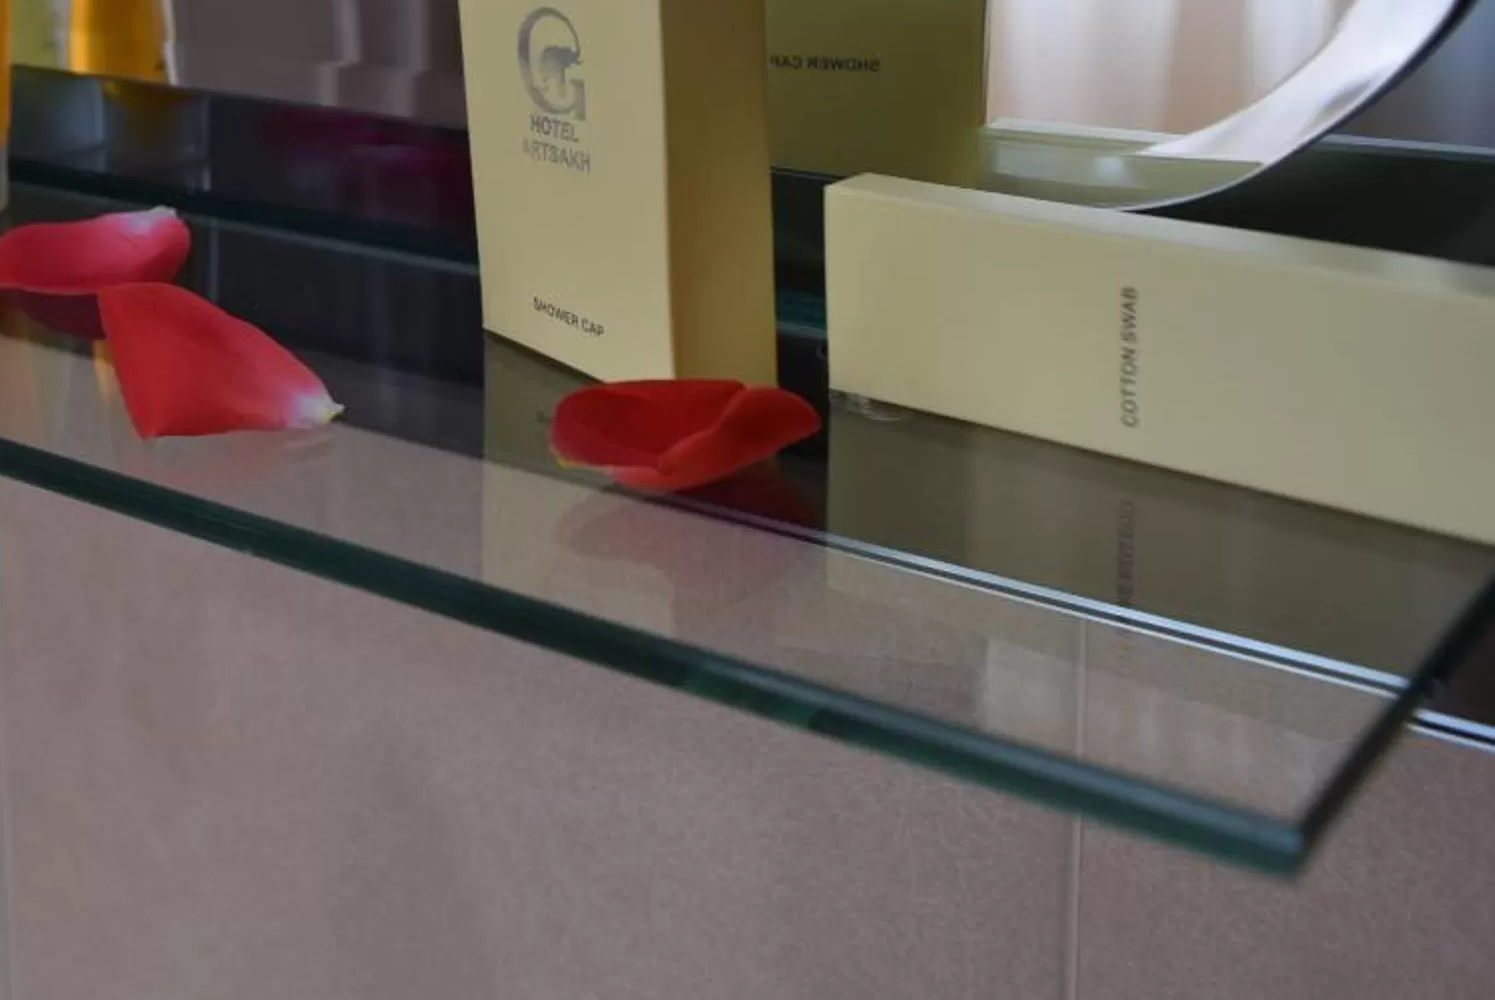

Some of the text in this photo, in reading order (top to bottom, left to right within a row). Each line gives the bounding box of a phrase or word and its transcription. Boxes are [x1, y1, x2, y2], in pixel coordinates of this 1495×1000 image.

[530, 115, 579, 142] HOTEL
[523, 138, 591, 175] ARTSAKH
[533, 296, 605, 336] SHOWER CAP
[1119, 286, 1139, 428] COTTON SWAB
